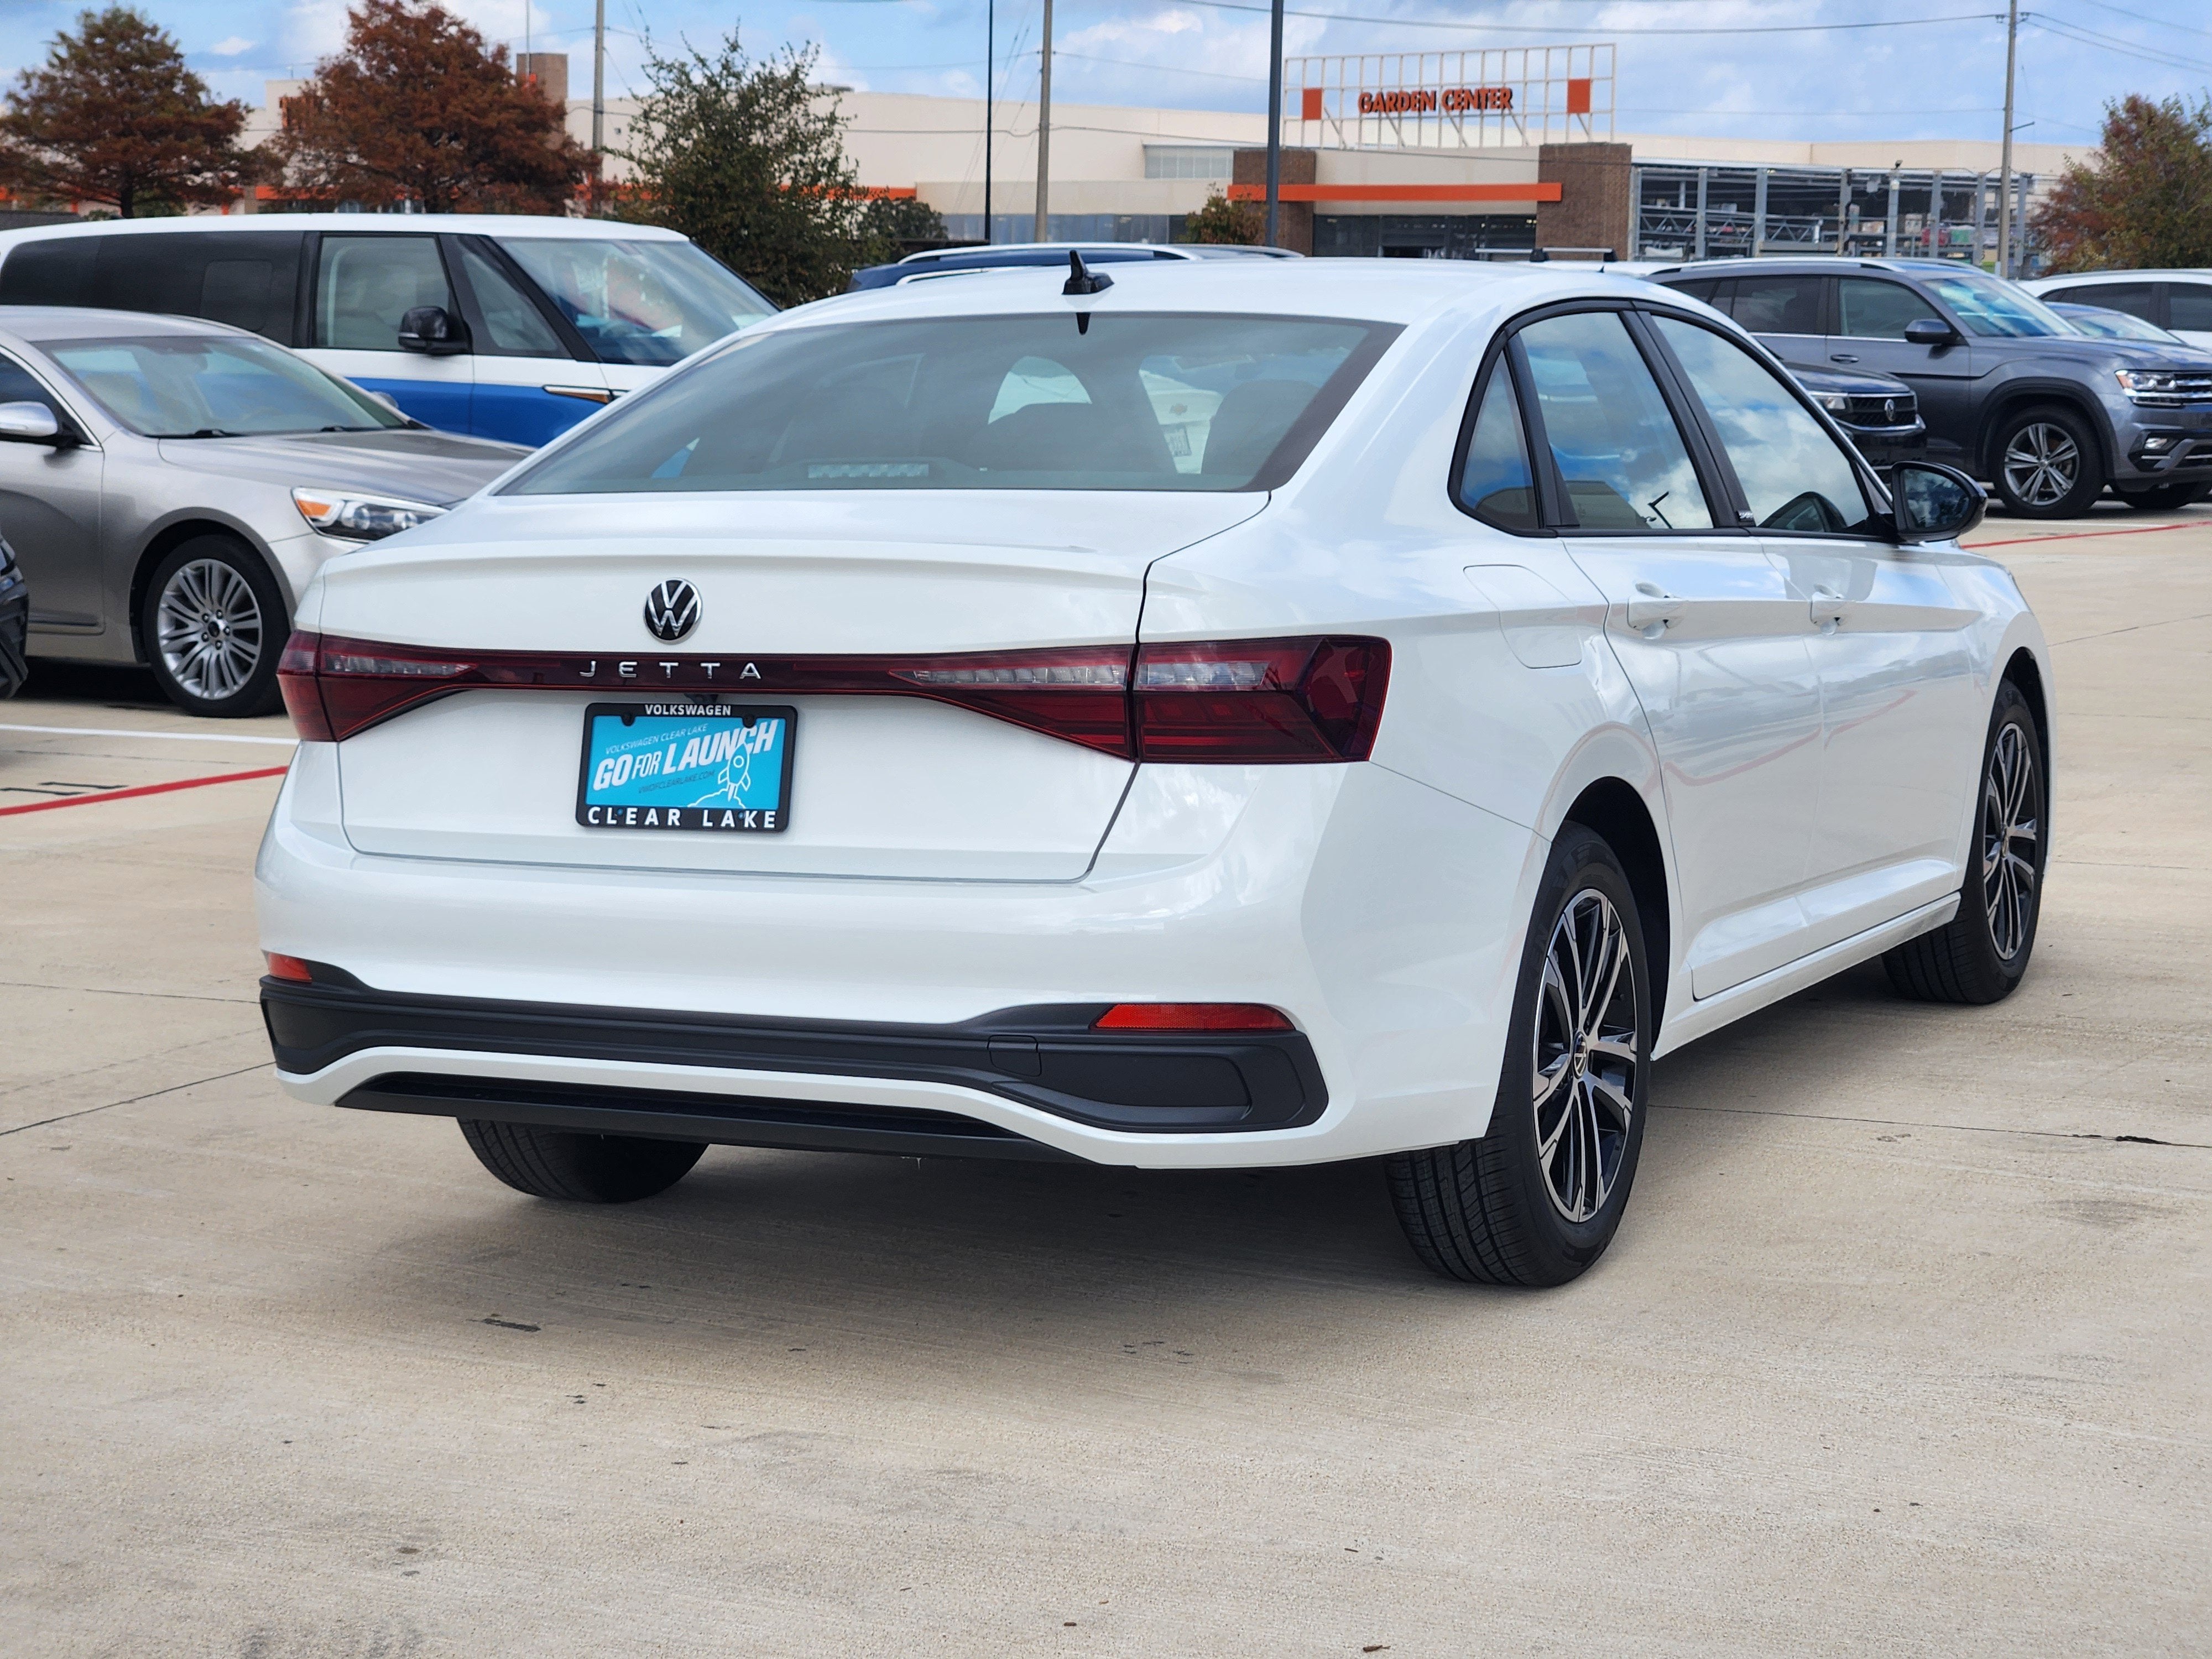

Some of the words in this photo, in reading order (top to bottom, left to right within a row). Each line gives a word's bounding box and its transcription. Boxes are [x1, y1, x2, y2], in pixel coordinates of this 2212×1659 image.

[1358, 91, 1437, 113] GARDEN
[1441, 87, 1514, 111] CENTER
[579, 660, 762, 680] JETTA
[645, 704, 731, 716] VOLKSWAGEN
[605, 734, 660, 755] VOLKSWAGEN
[660, 728, 687, 743] CLEAR
[687, 723, 708, 736] LAKE
[593, 754, 634, 791] GO
[631, 750, 662, 780] FOR
[662, 719, 779, 775] LAUNCH
[587, 806, 681, 826] CLEAR
[702, 810, 776, 829] LAKE
